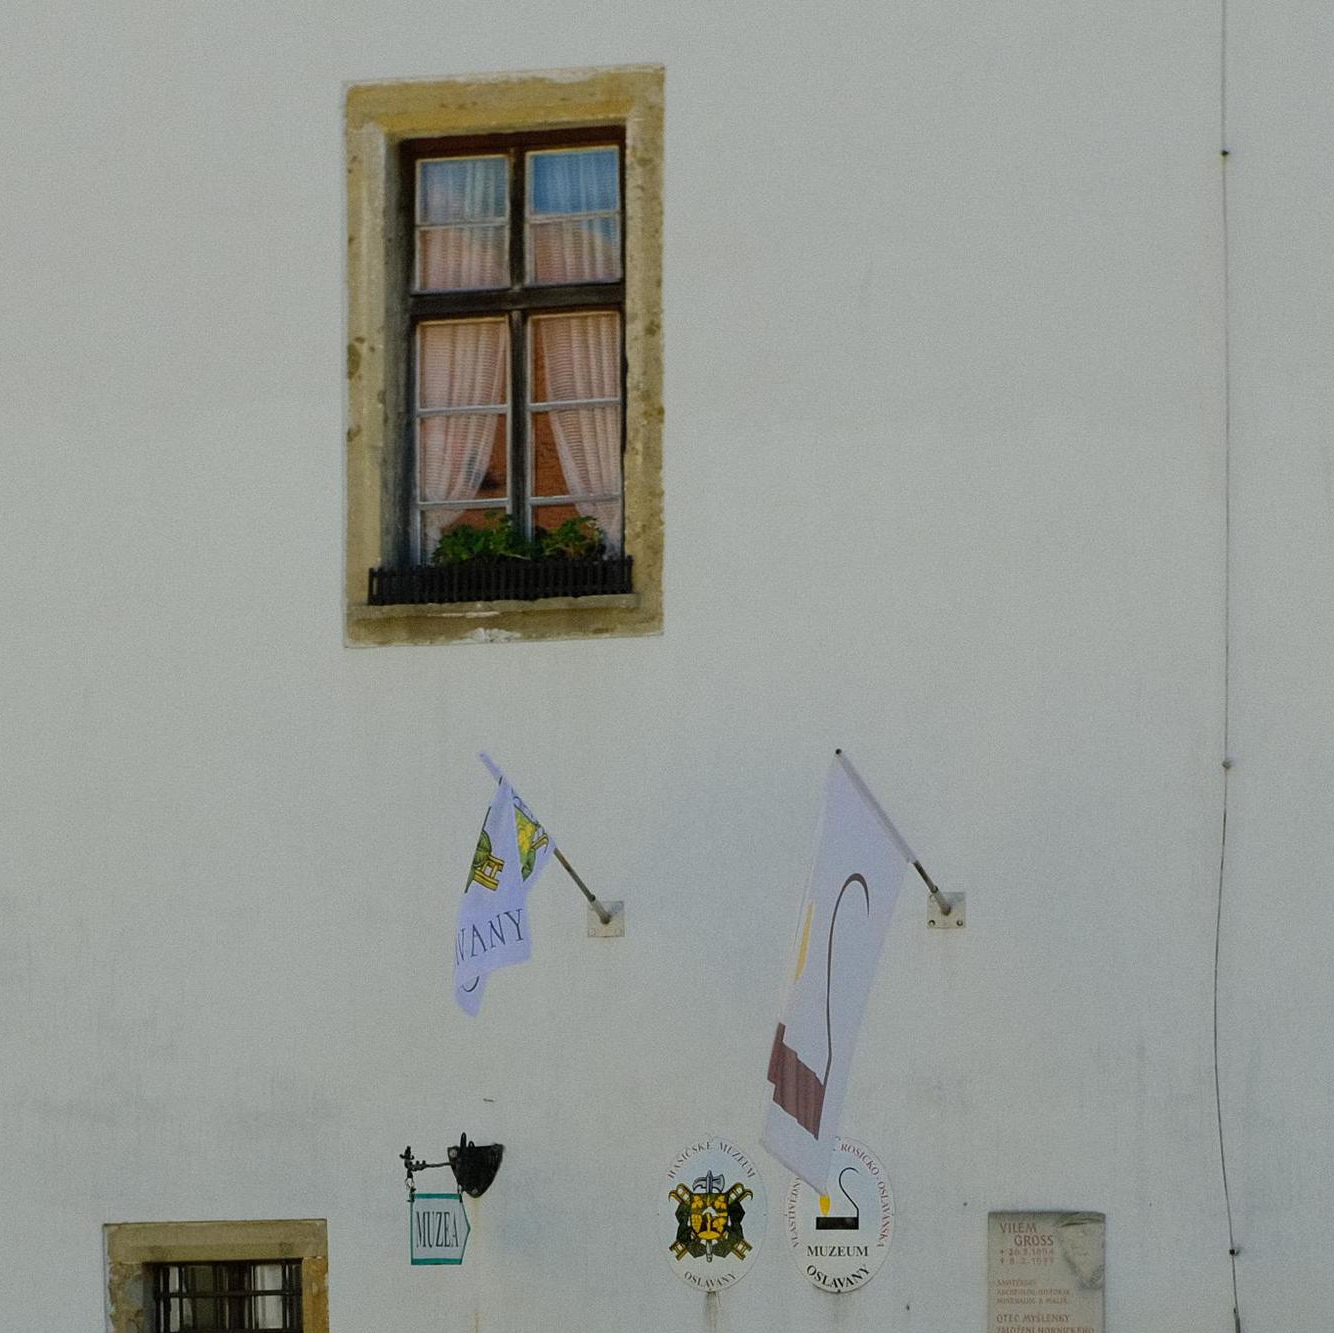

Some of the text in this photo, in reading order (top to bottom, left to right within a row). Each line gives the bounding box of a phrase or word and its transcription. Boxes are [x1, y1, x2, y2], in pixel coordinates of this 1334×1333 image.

[718, 1142, 756, 1178] MUZEUM
[416, 1211, 459, 1248] MUZEA
[1014, 1235, 1054, 1246] GROSS
[807, 1246, 868, 1257] MUZEUM
[684, 1271, 736, 1288] OSLAVANY
[807, 1265, 870, 1288] OSLAVANY
